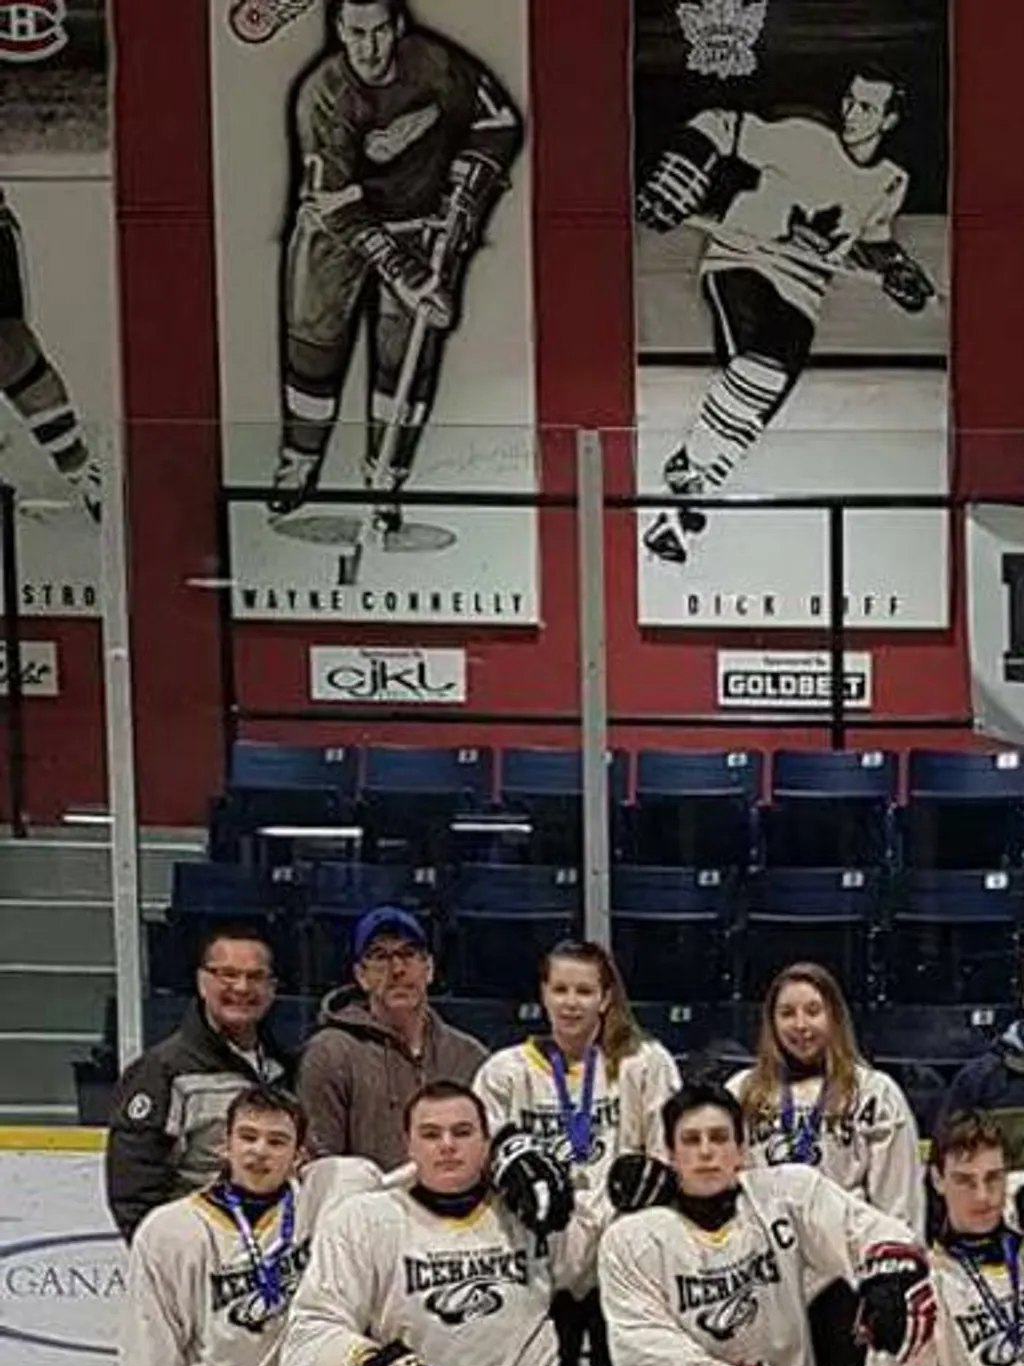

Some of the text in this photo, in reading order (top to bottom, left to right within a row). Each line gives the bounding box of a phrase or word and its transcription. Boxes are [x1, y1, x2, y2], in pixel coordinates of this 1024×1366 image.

[243, 588, 523, 614] WAYNE CONNELLY
[687, 593, 775, 616] DICK
[727, 673, 863, 697] GOLDBET
[858, 1096, 878, 1127] A
[770, 1218, 796, 1250] C
[403, 1249, 529, 1296] ICEHAWKS
